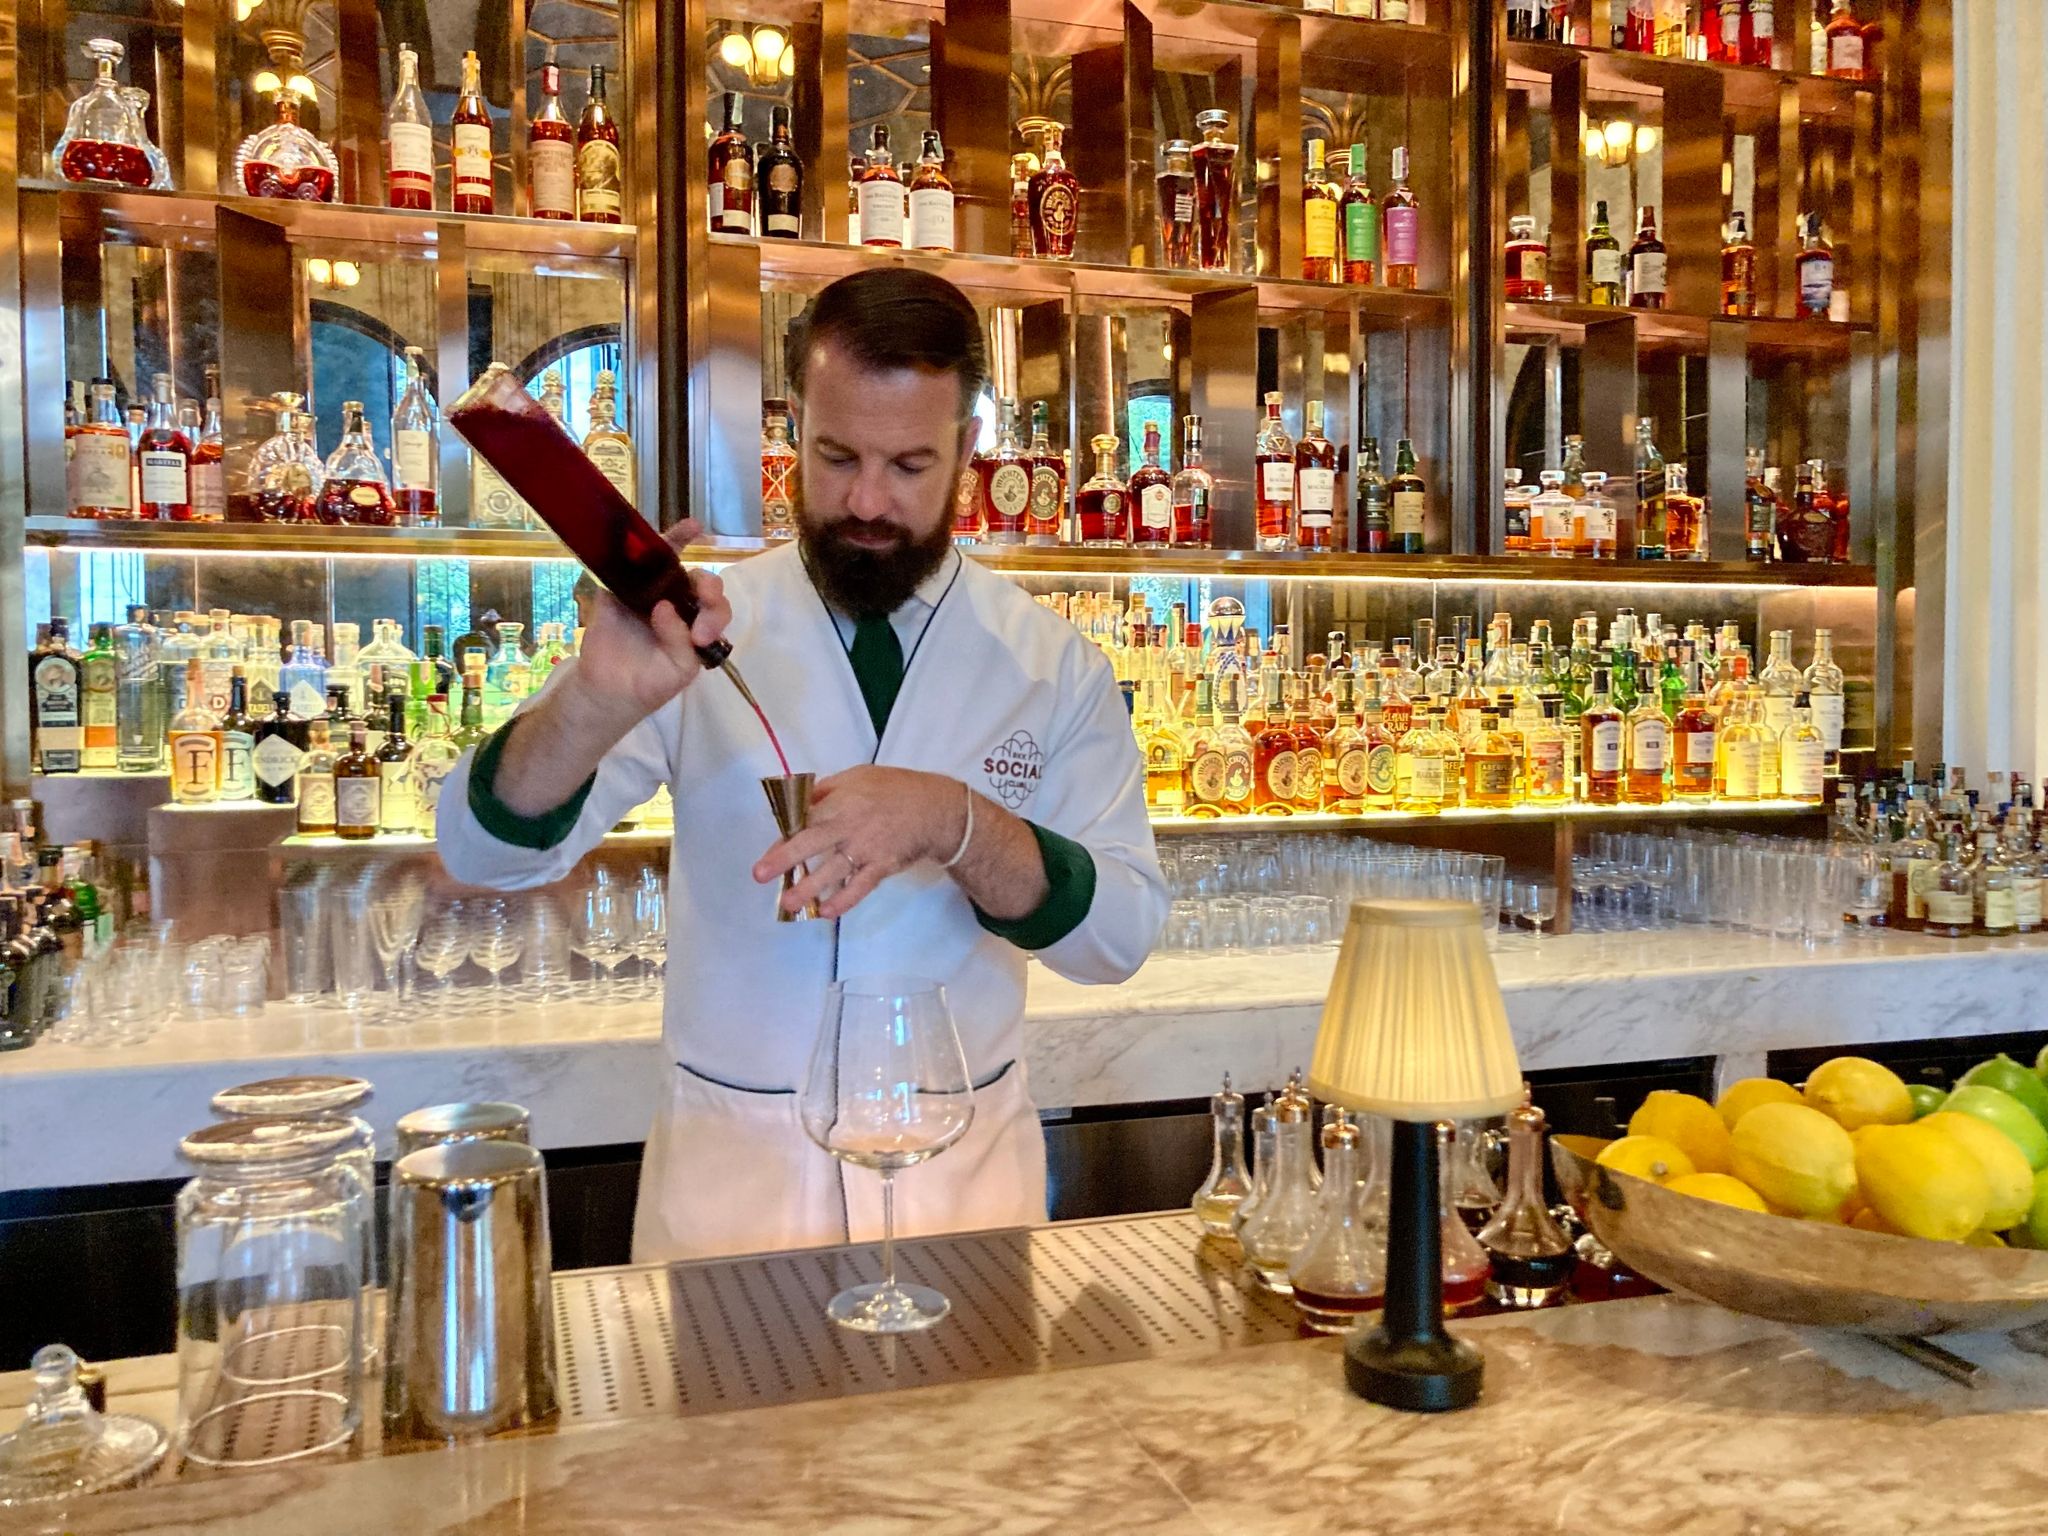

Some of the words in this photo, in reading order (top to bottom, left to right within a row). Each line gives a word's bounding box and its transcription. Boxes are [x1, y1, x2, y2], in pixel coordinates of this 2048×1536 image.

[188, 750, 214, 785] F
[225, 747, 251, 783] F
[983, 757, 1042, 780] SOCIAL
